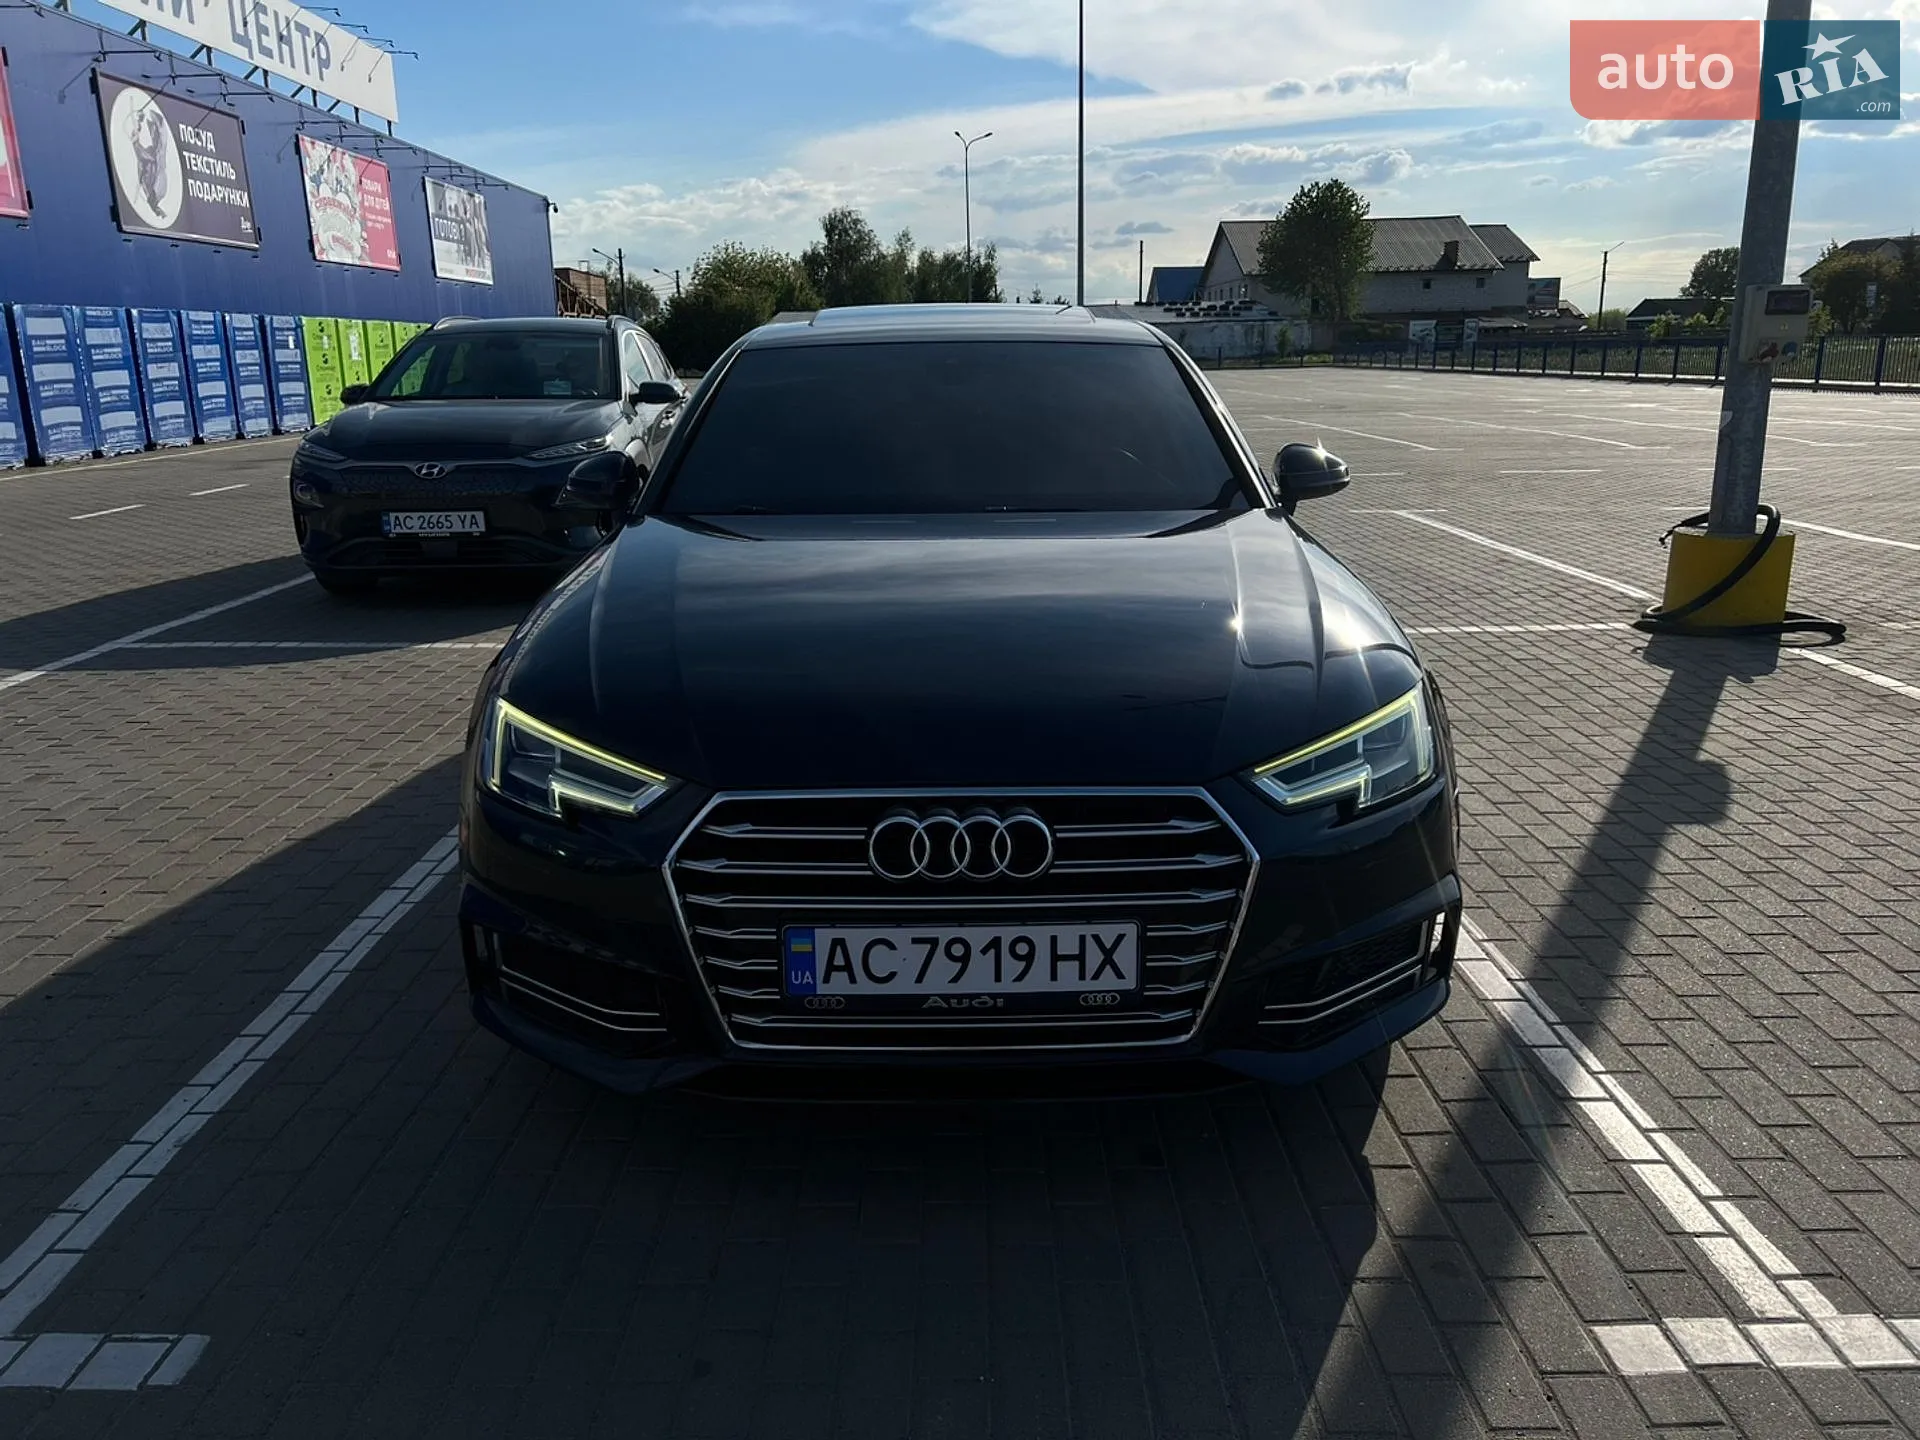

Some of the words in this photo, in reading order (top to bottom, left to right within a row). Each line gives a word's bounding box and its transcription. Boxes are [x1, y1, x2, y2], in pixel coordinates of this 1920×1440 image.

[227, 0, 331, 82] ЦЕНТР
[178, 123, 216, 152] ПОСУД
[183, 151, 236, 180] ТЕКСТИЛЬ
[188, 178, 250, 208] ПОДАРУНКИ
[393, 515, 414, 531] AC
[417, 514, 454, 530] 2665
[457, 514, 480, 529] YA
[822, 936, 899, 985] AC
[910, 935, 1036, 985] 7919
[1050, 933, 1127, 982] HX
[791, 971, 814, 985] UA
[921, 996, 1005, 1009] Audi
